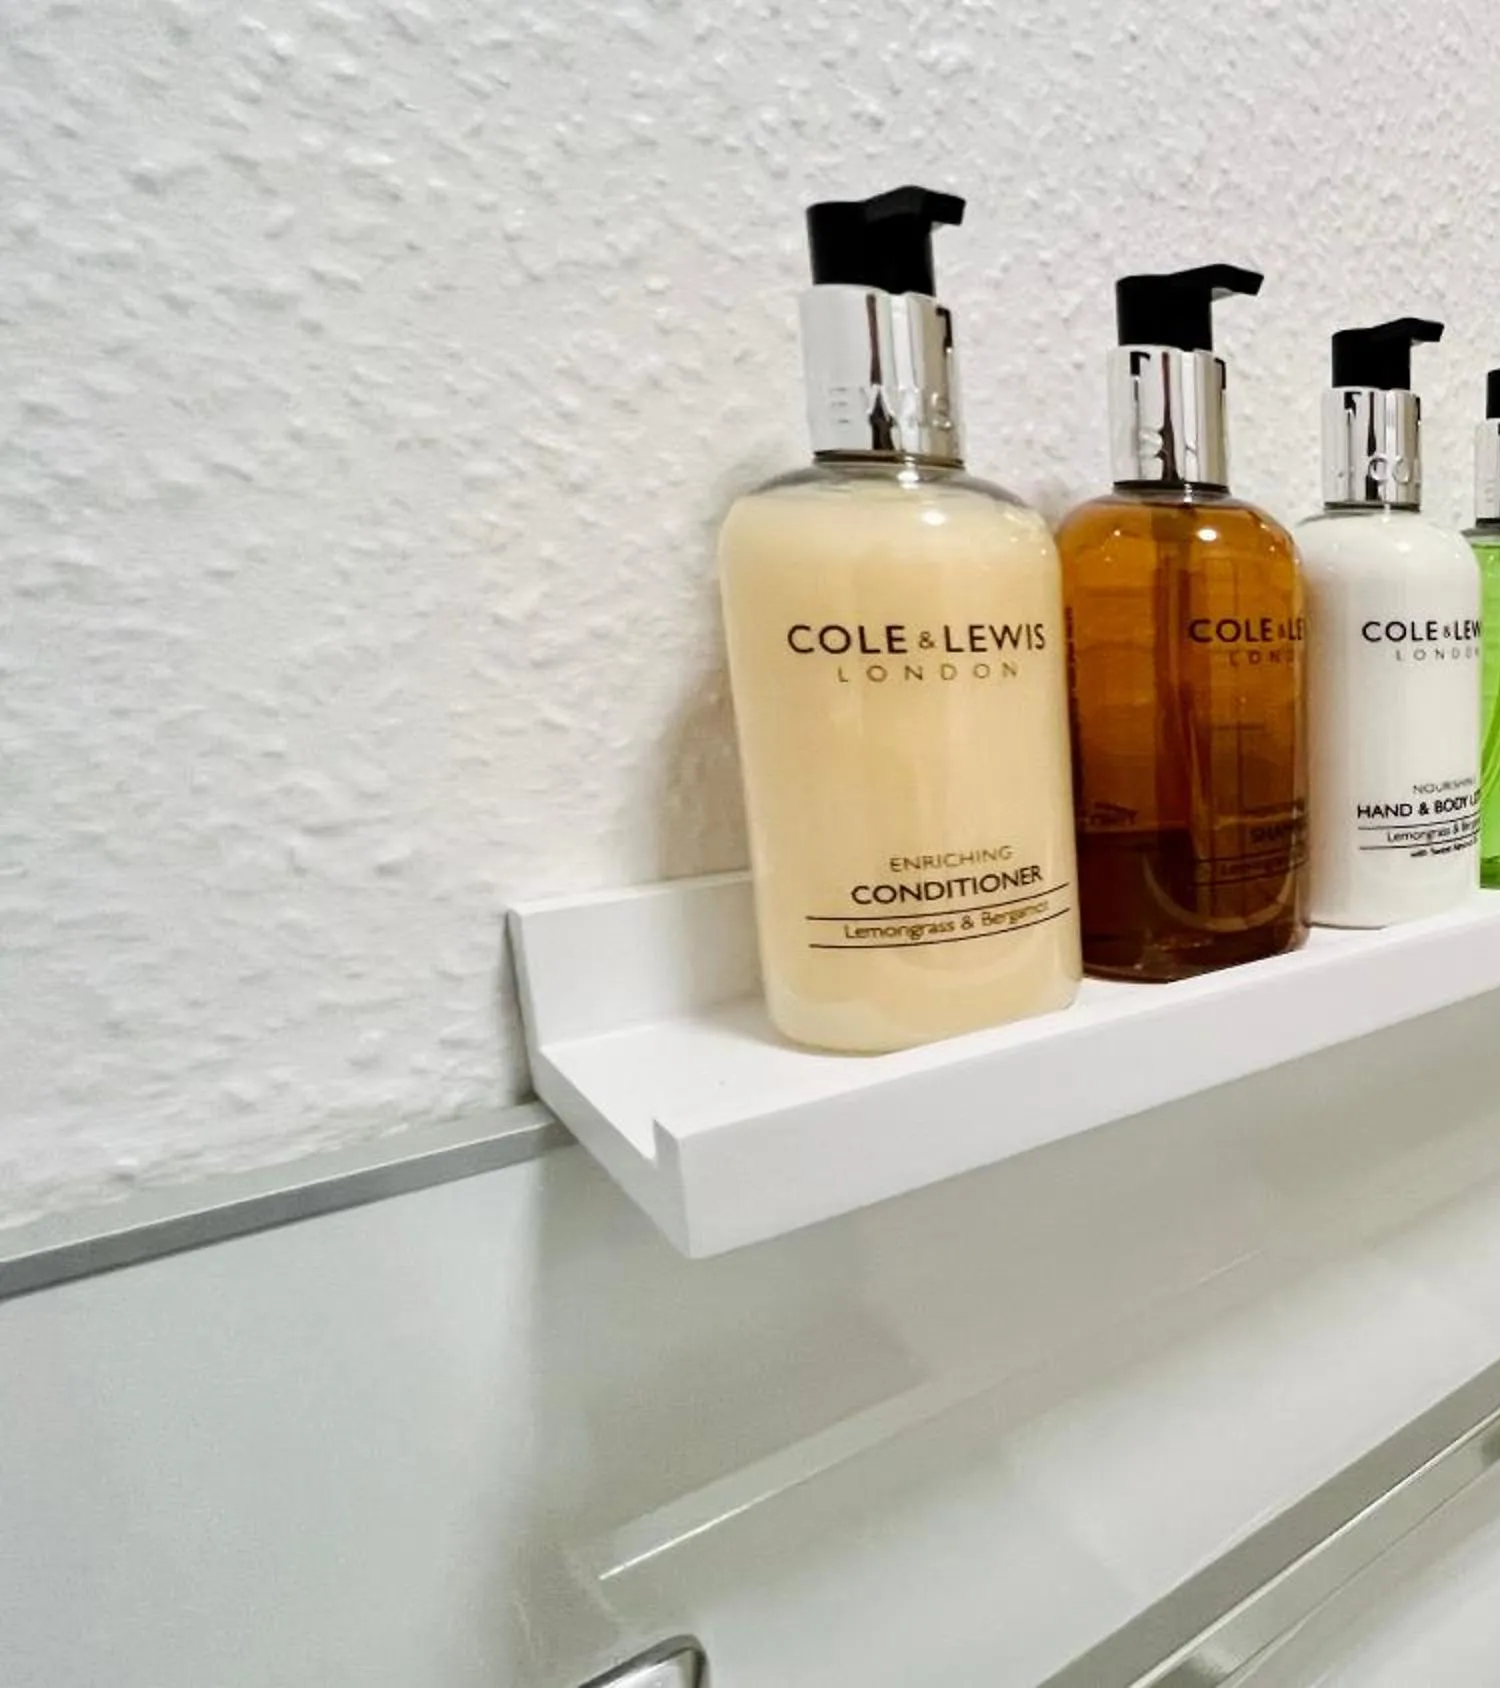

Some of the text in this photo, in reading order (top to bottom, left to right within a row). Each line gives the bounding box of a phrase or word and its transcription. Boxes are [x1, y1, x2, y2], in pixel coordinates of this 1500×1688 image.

[787, 623, 1047, 655] COLE & LEWIS
[1189, 617, 1273, 643] COLE
[1361, 620, 1438, 642] COLE
[1454, 619, 1482, 641] LEW
[837, 661, 1019, 683] LONDON
[1356, 802, 1413, 820] HAND
[1418, 801, 1430, 817] &
[889, 845, 1014, 873] ENRICHING
[850, 864, 1044, 905] CONDITIONER
[844, 920, 956, 941] Lemongrass
[960, 914, 975, 932] &
